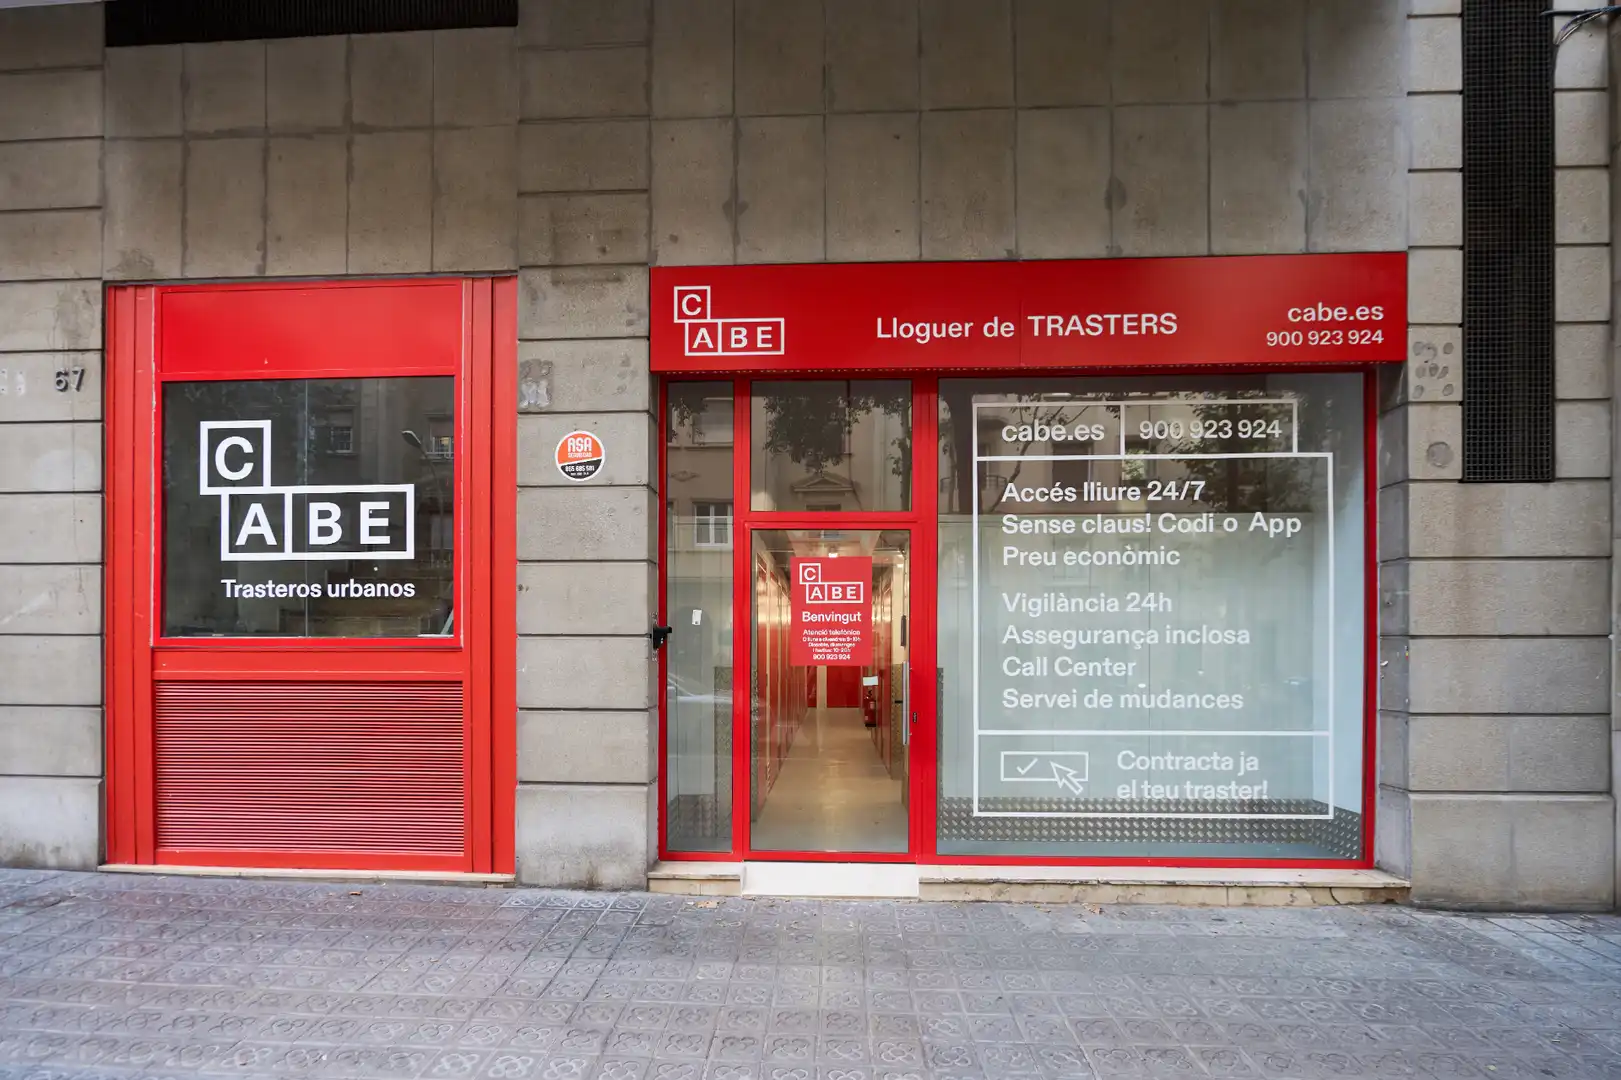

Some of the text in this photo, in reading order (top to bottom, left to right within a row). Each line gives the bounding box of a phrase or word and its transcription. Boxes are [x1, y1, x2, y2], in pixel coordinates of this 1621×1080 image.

[1288, 301, 1384, 322] cabe.es
[876, 312, 1178, 343] Lloguer de TRASTERS
[1266, 329, 1384, 346] 900 923 924
[55, 366, 85, 392] 67
[1001, 418, 1283, 442] cabe.es 900 923 924
[1001, 480, 1206, 503] Accés lliure 24/7
[1001, 512, 1302, 537] Sense claus! Codi o App
[1002, 544, 1181, 567] Preu econòmic
[220, 578, 416, 598] Trasteros urbanos
[1002, 592, 1173, 617] Vigilància 24h
[801, 611, 862, 625] Benvingut
[1002, 625, 1251, 650] Assegurança inclosa
[1002, 657, 1137, 677] Call Center
[1002, 689, 1244, 709] Servei de mudances
[1117, 750, 1259, 776] Contracta ja
[1117, 780, 1268, 801] el teu traster!
